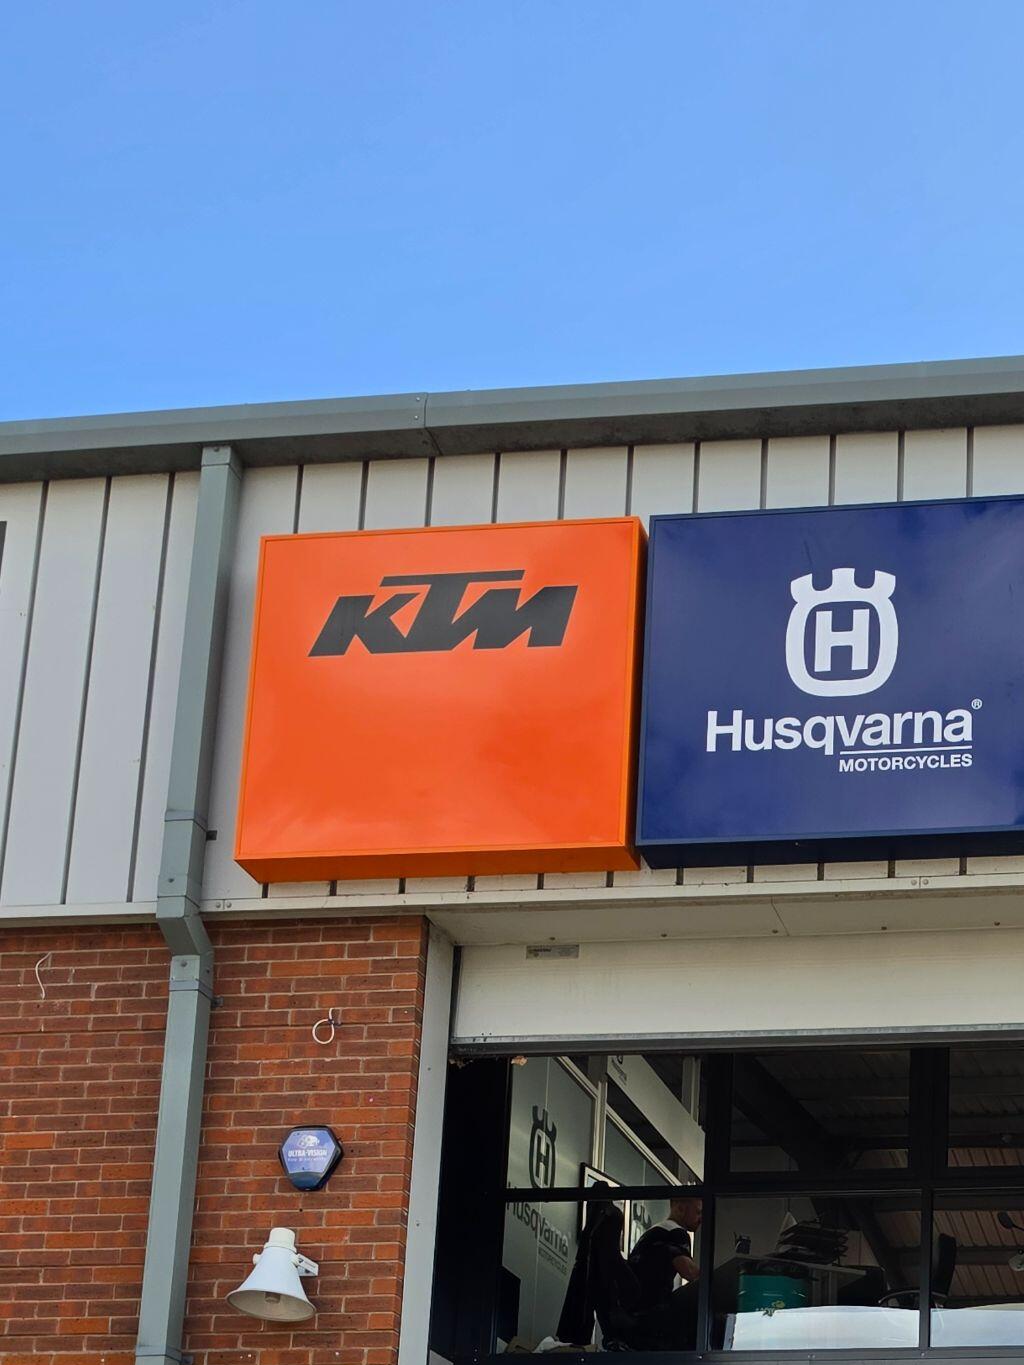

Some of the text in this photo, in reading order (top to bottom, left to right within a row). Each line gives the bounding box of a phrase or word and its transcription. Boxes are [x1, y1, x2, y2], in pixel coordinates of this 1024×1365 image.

[308, 569, 579, 657] KTM
[706, 708, 973, 756] Husqvarna
[838, 753, 973, 773] MOTORCYCLES
